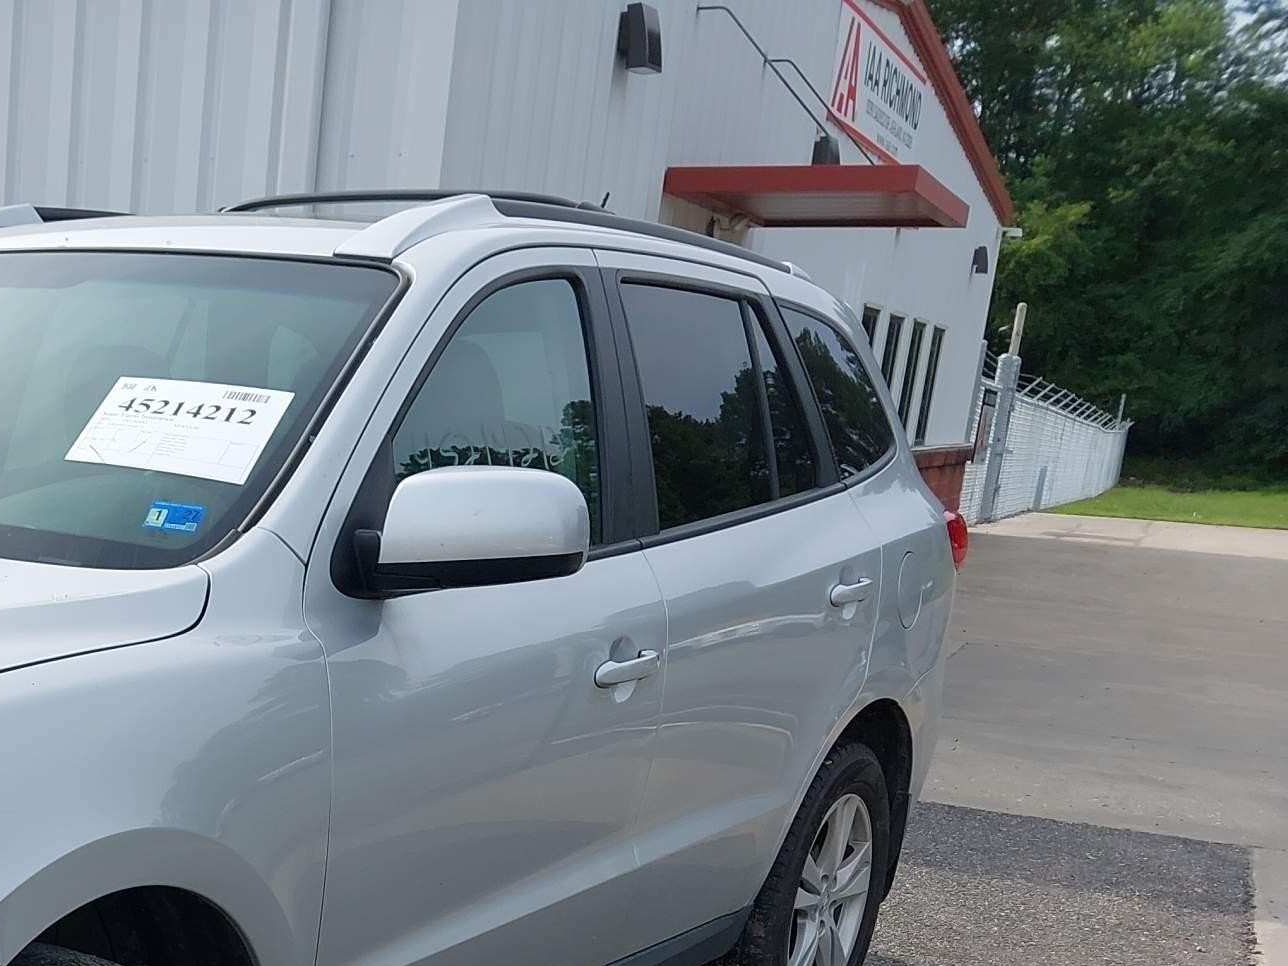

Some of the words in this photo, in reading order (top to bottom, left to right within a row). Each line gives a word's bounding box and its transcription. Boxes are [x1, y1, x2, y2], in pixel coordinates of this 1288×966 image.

[864, 40, 882, 95] IAA
[880, 58, 922, 131] RICHMOND
[118, 397, 258, 425] 45214212
